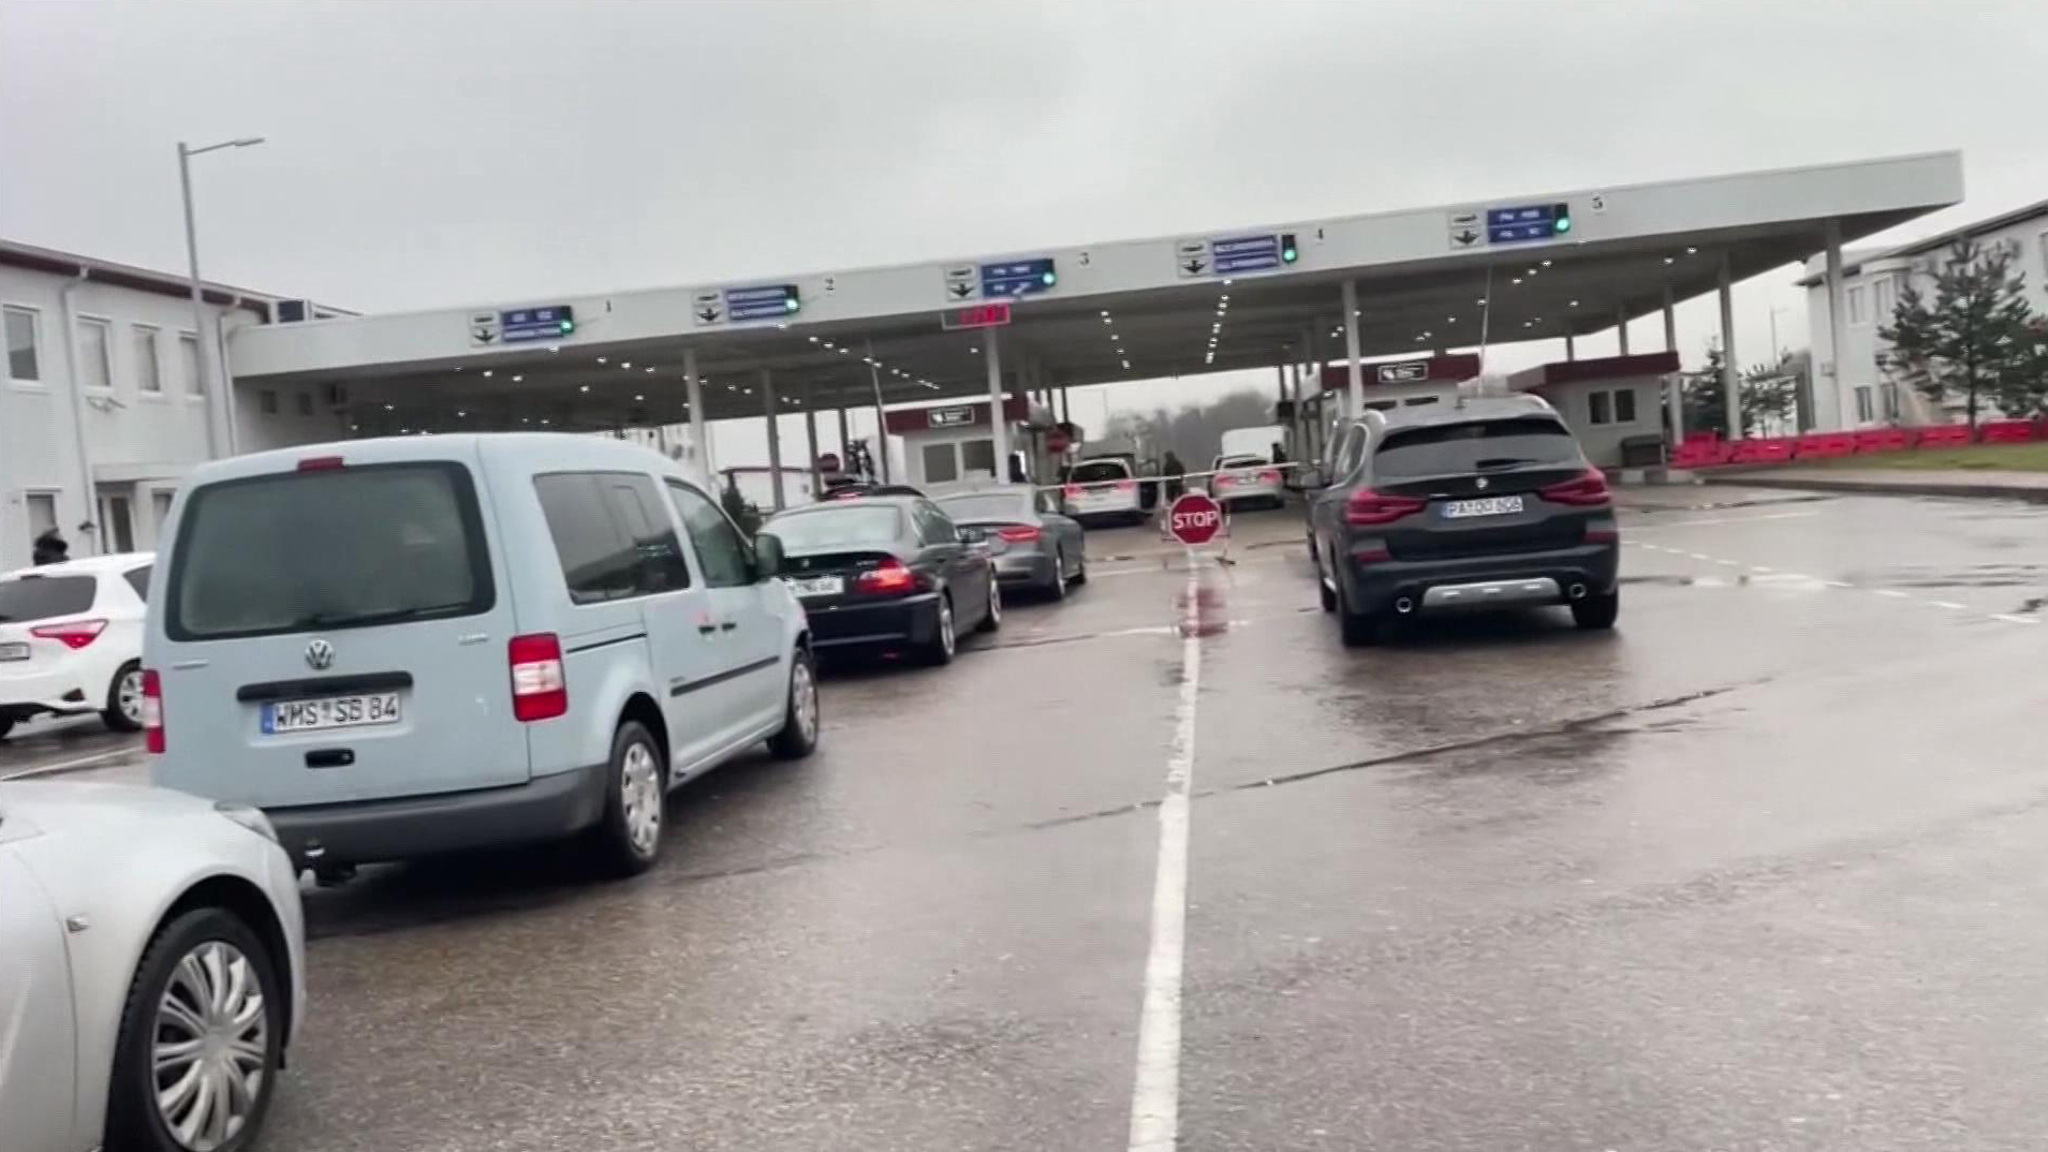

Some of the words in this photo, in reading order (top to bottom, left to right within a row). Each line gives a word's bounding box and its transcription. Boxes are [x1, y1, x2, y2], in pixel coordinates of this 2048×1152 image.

[1173, 510, 1217, 530] STOP
[275, 701, 318, 726] WMS
[335, 699, 362, 723] SB
[370, 696, 397, 720] 84
